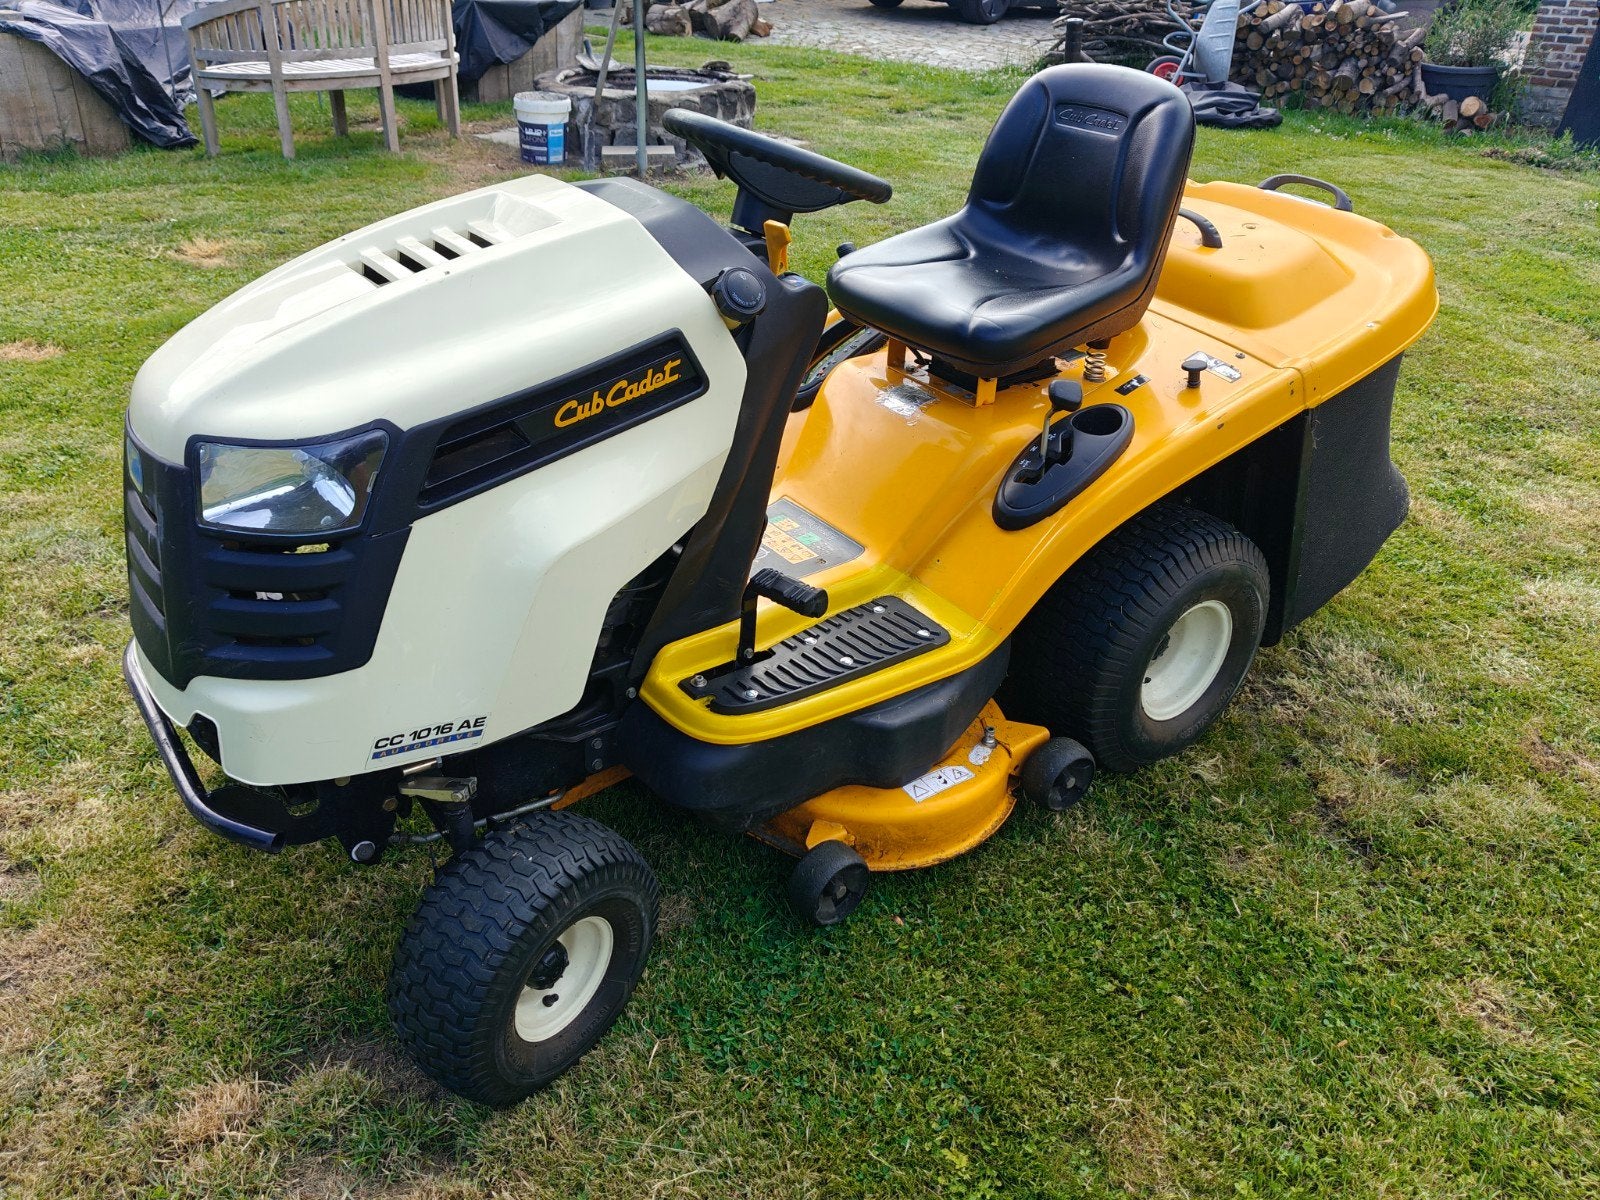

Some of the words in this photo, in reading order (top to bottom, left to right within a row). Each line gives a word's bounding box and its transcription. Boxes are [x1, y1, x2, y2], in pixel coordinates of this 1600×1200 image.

[554, 391, 605, 428] Cub
[605, 358, 682, 407] Cadet
[374, 733, 405, 750] CC
[409, 722, 454, 741] 1016
[457, 716, 488, 732] AE
